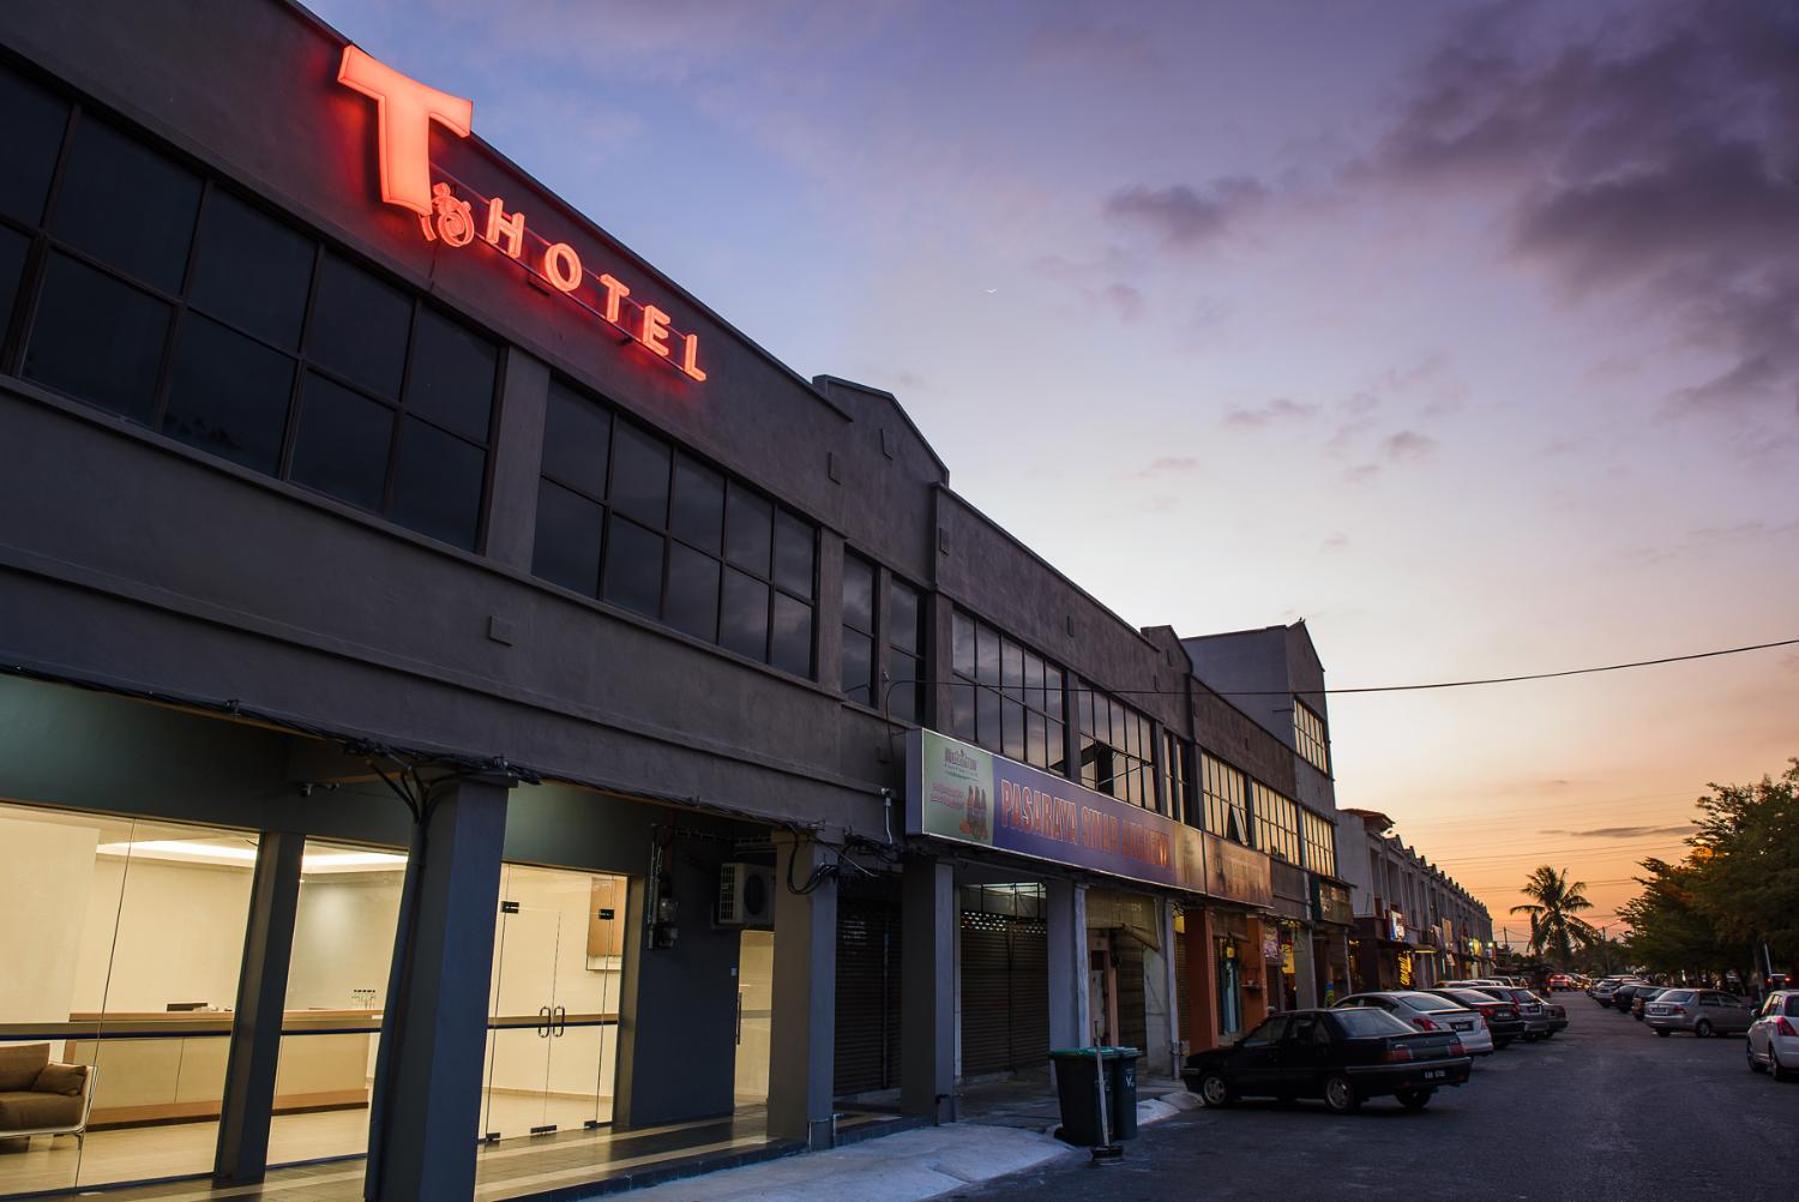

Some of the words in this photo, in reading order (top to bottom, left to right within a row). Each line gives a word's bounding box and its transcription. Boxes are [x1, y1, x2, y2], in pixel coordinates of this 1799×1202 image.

[338, 44, 473, 216] T
[486, 197, 706, 382] HOTEL
[1001, 778, 1078, 845] PASARAYA
